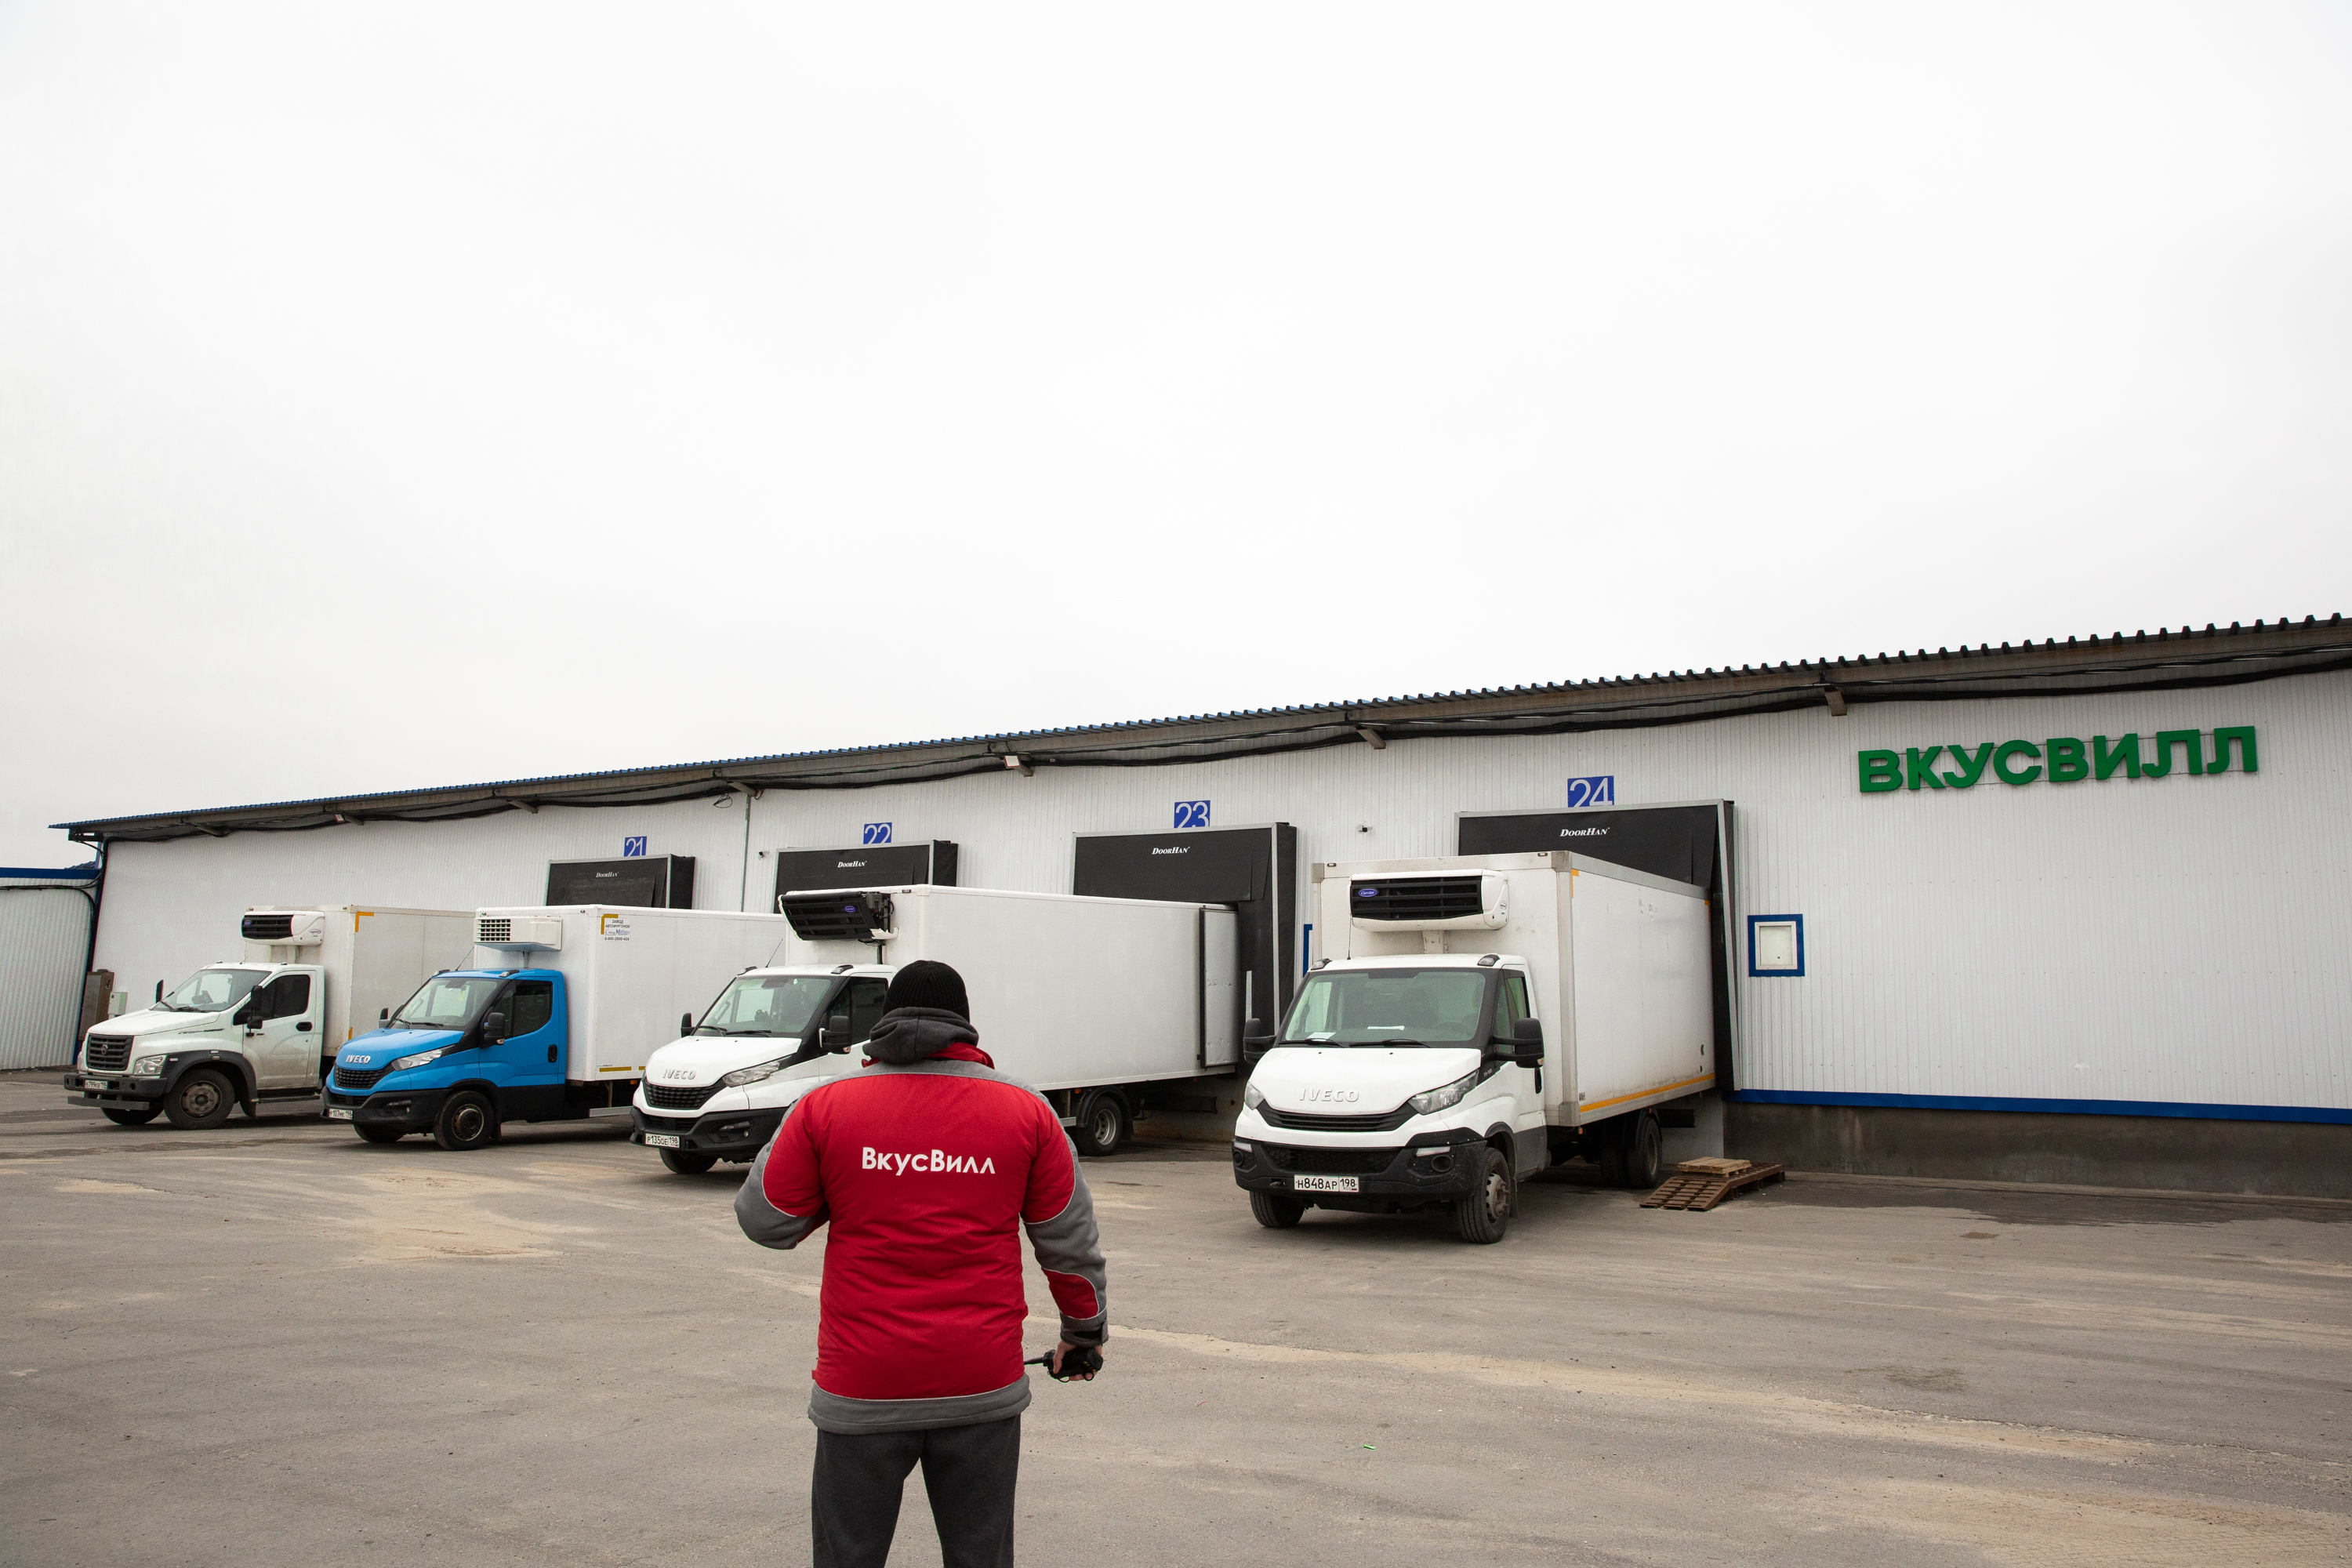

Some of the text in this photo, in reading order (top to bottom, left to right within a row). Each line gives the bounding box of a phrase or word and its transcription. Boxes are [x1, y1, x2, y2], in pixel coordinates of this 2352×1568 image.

[1858, 726, 2257, 793] ВКУСВИЛЛ
[1570, 778, 1613, 808] 24
[1176, 801, 1209, 828] 23
[864, 823, 891, 844] 22
[626, 837, 643, 857] 21
[346, 1054, 371, 1063] IVECO
[662, 1069, 696, 1080] IVECO
[1299, 1088, 1359, 1102] IVECO
[862, 1147, 996, 1176] ВкусВилл
[1340, 1178, 1356, 1187] 198
